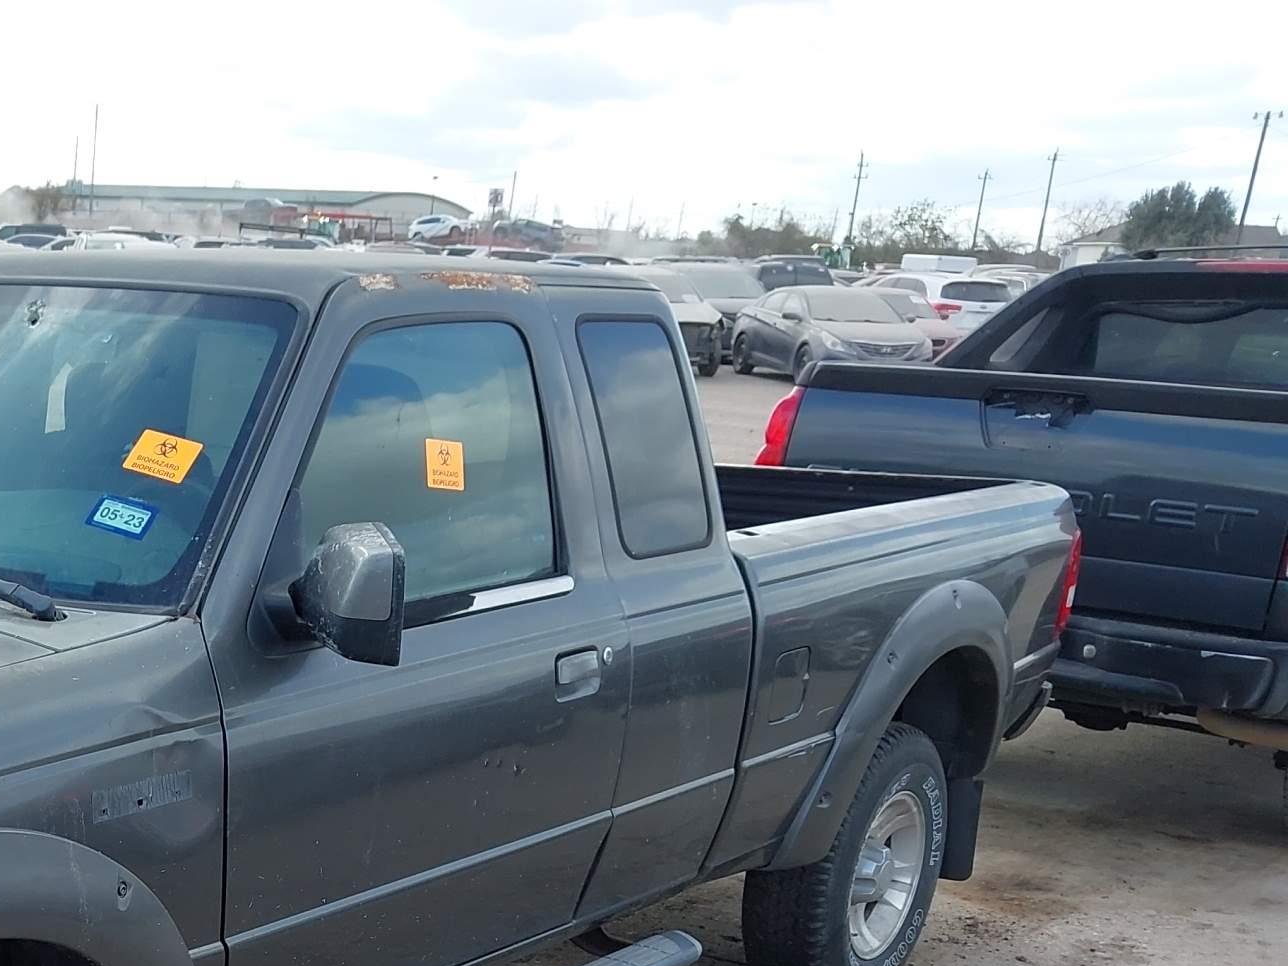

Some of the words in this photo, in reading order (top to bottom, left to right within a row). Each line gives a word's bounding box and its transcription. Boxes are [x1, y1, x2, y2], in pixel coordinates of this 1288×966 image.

[132, 462, 176, 479] BIOPELIGRO
[136, 454, 180, 472] BIOHAZARD
[100, 506, 121, 521] 05
[123, 513, 145, 528] 23
